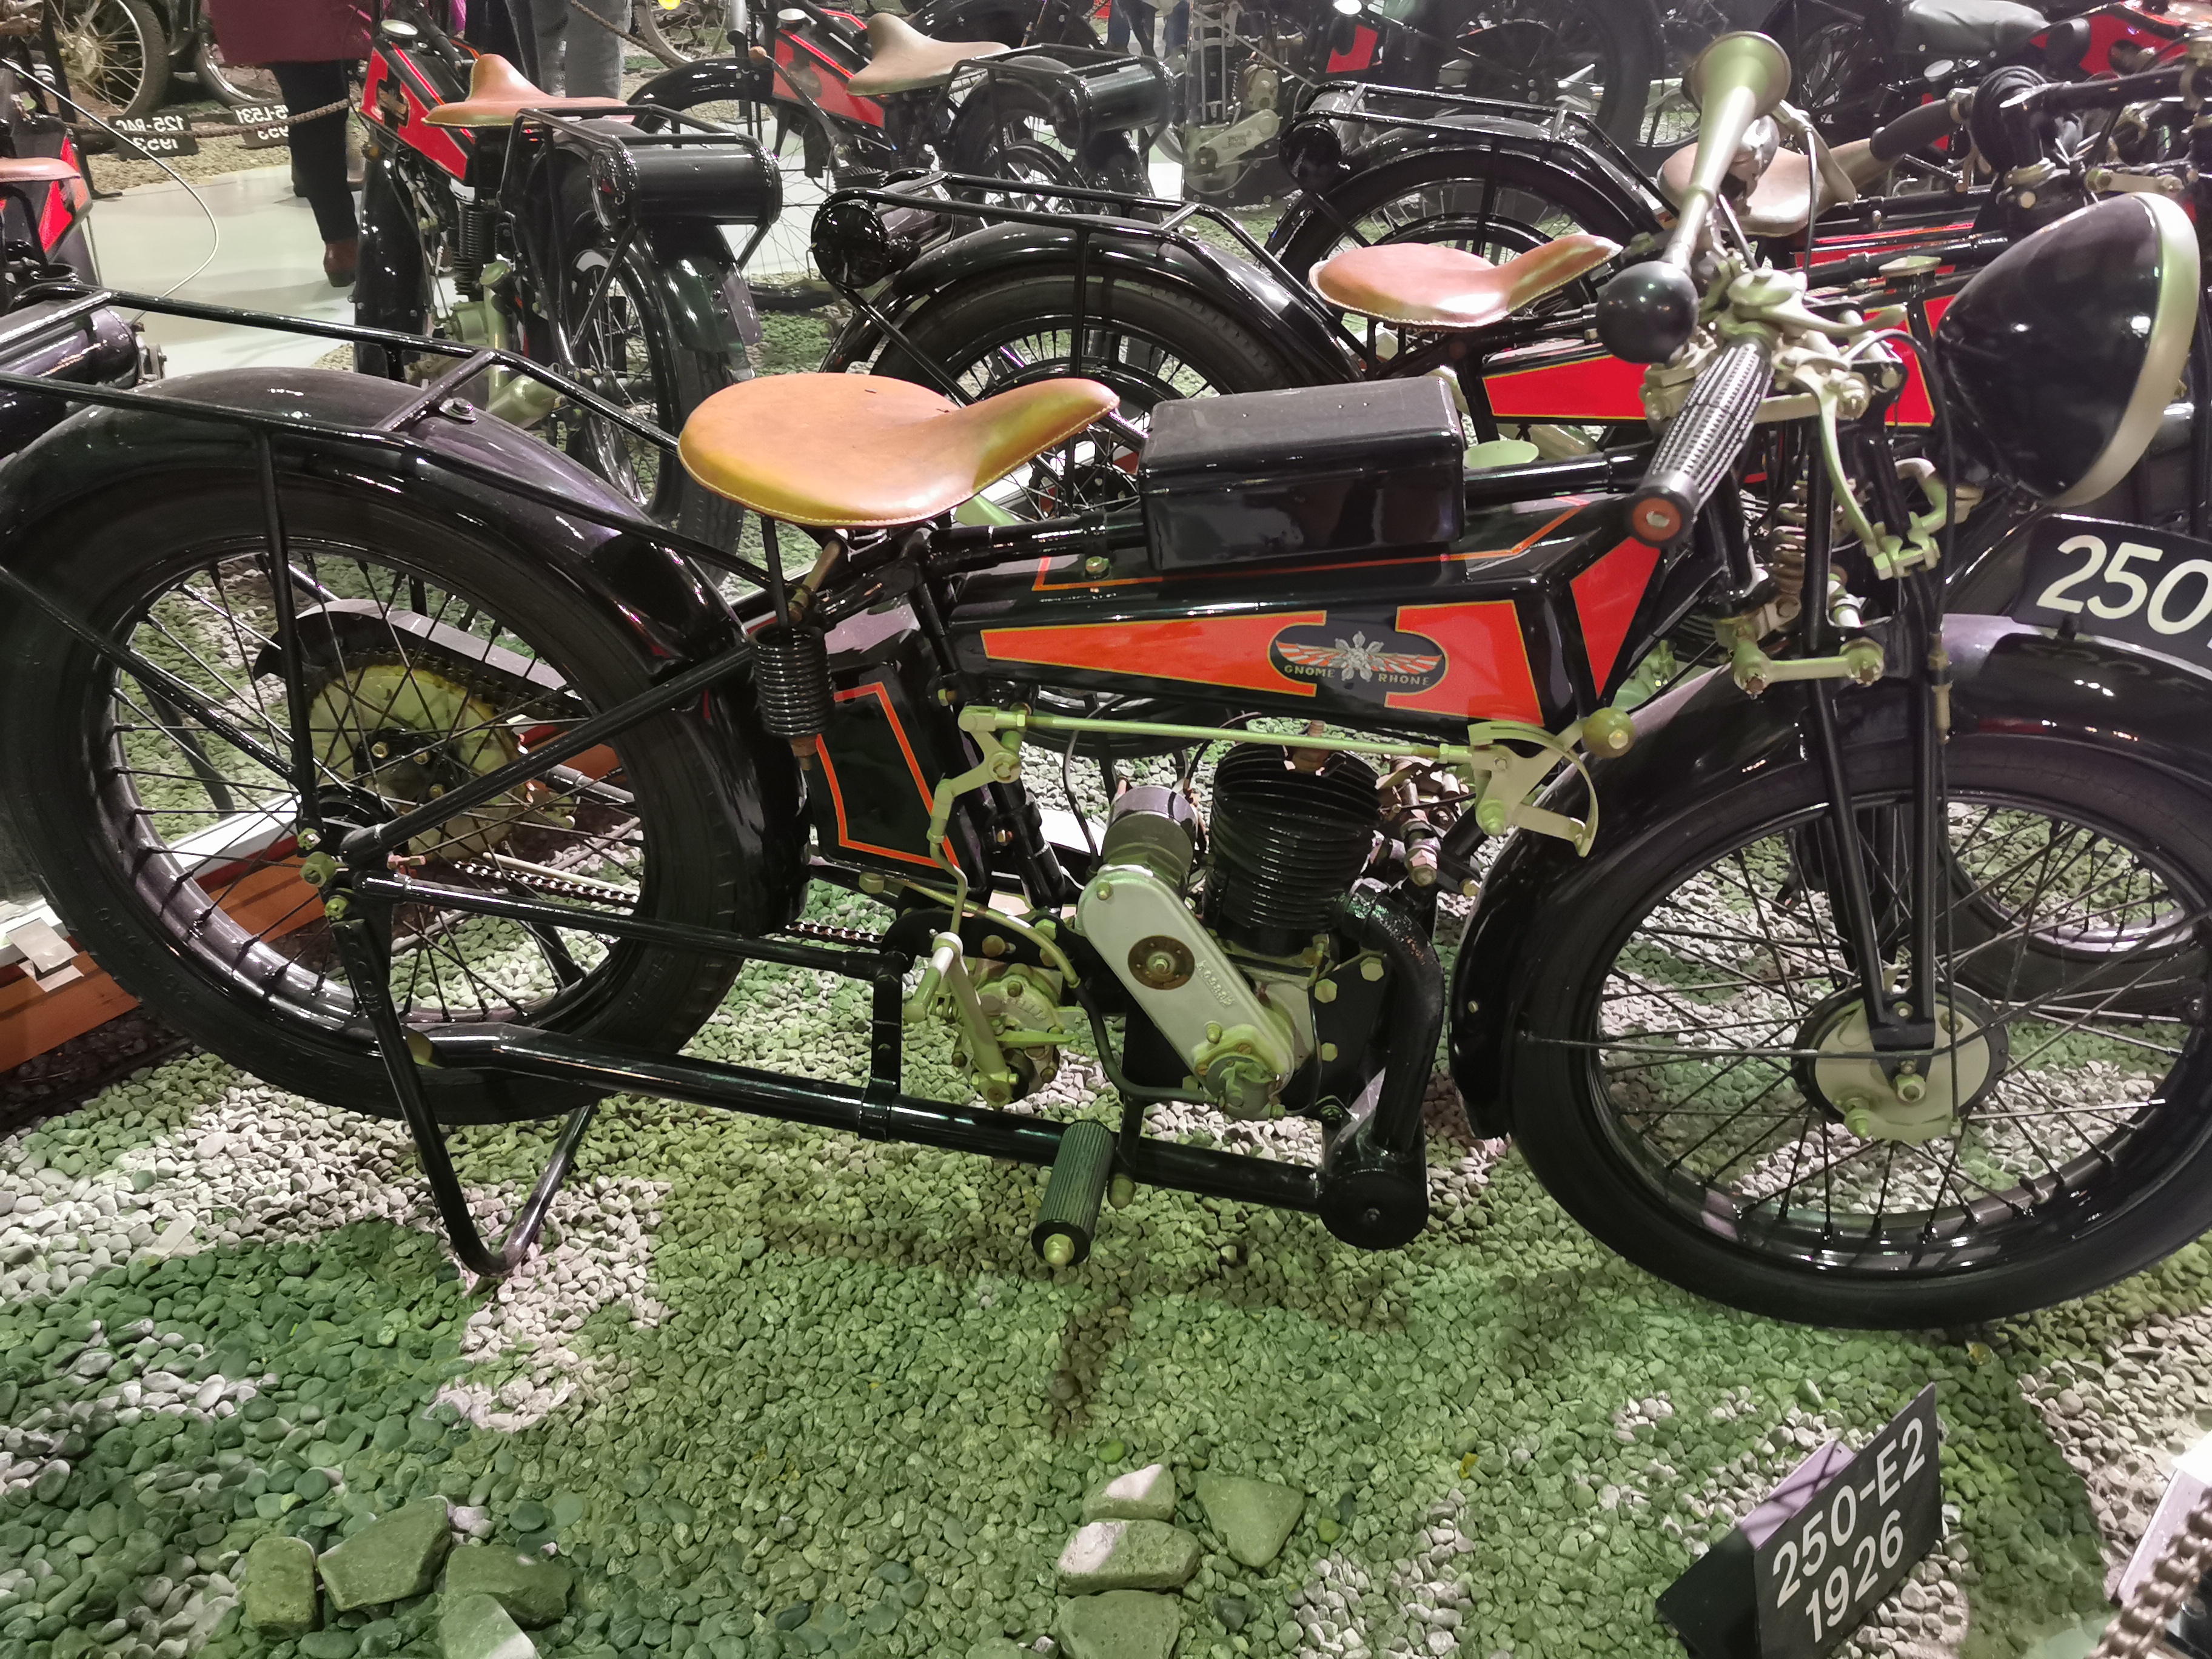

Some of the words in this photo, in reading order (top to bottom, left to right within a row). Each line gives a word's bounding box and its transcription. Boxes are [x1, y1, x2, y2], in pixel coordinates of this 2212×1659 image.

[2036, 534, 2212, 650] 250
[1284, 665, 1335, 678] GNOME
[1378, 673, 1430, 686] RHONE
[1773, 1418, 1925, 1609] 250-E2
[1806, 1509, 1903, 1643] 1926
